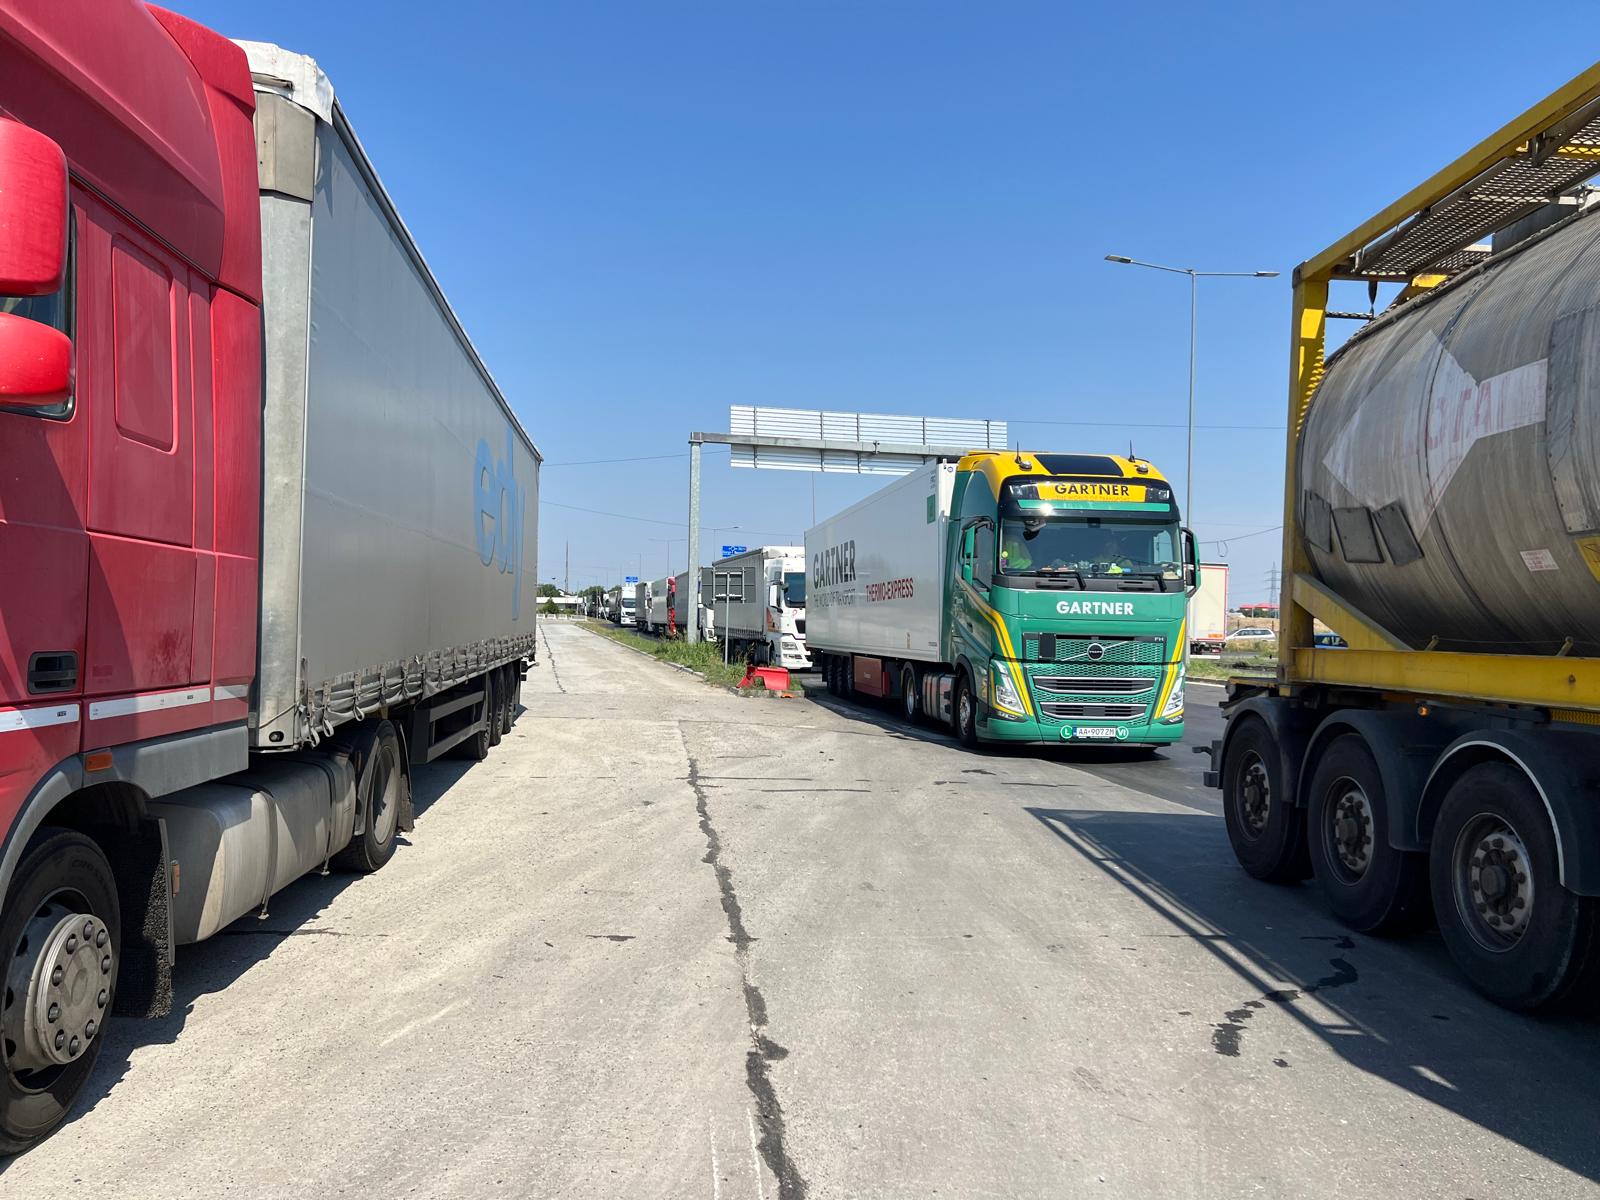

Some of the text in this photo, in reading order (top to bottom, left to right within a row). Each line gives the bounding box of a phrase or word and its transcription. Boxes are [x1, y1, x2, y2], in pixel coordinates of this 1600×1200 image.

[1055, 484, 1129, 496] GARTNER
[814, 540, 856, 588] GARTNER
[866, 578, 914, 602] THERMO-EXPRESS
[1056, 601, 1134, 615] GARTNER
[1064, 728, 1070, 736] L
